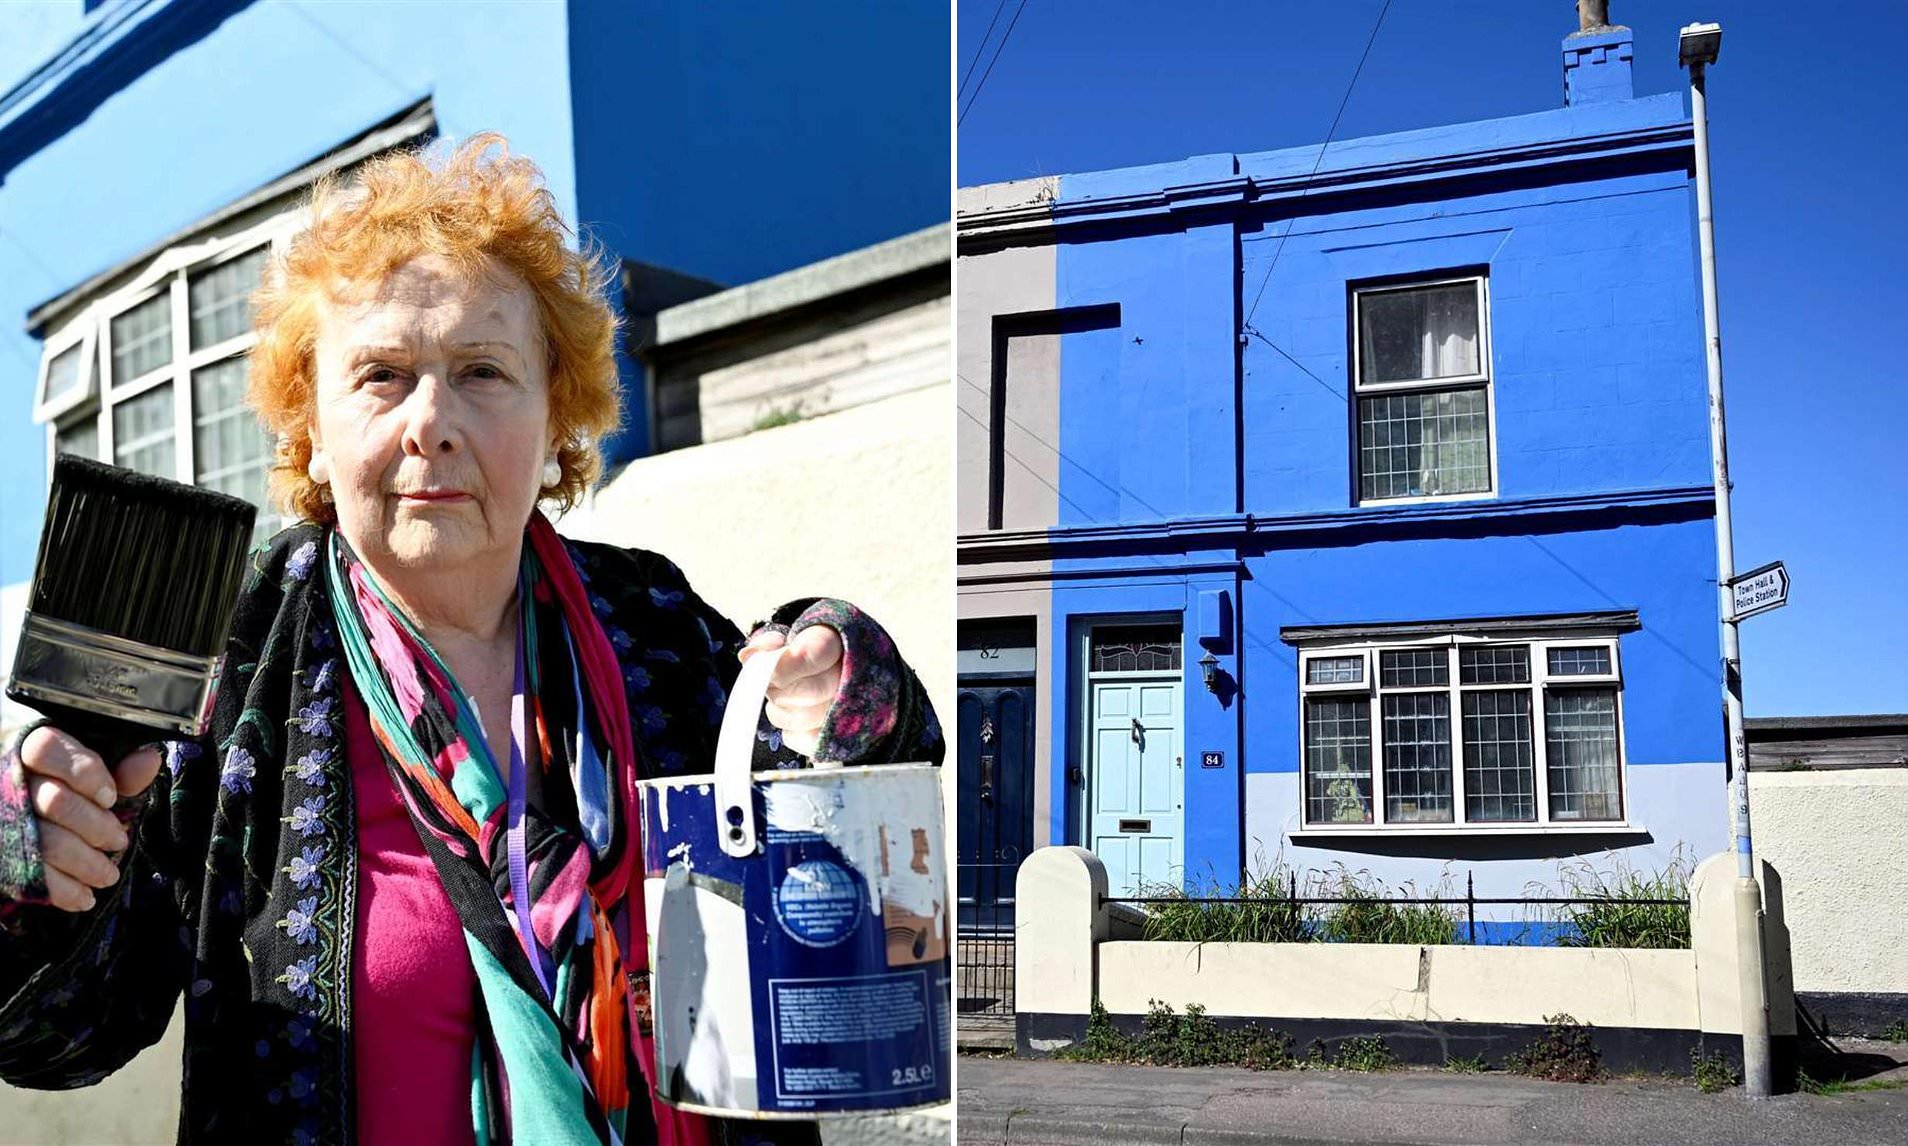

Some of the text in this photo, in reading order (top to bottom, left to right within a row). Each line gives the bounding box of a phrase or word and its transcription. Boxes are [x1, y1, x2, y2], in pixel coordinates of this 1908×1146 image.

[1738, 574, 1774, 595] Town Hall &
[1736, 588, 1778, 608] Police Station
[980, 644, 999, 660] 82
[1206, 755, 1219, 765] 84
[892, 1066, 921, 1086] 2.5L
